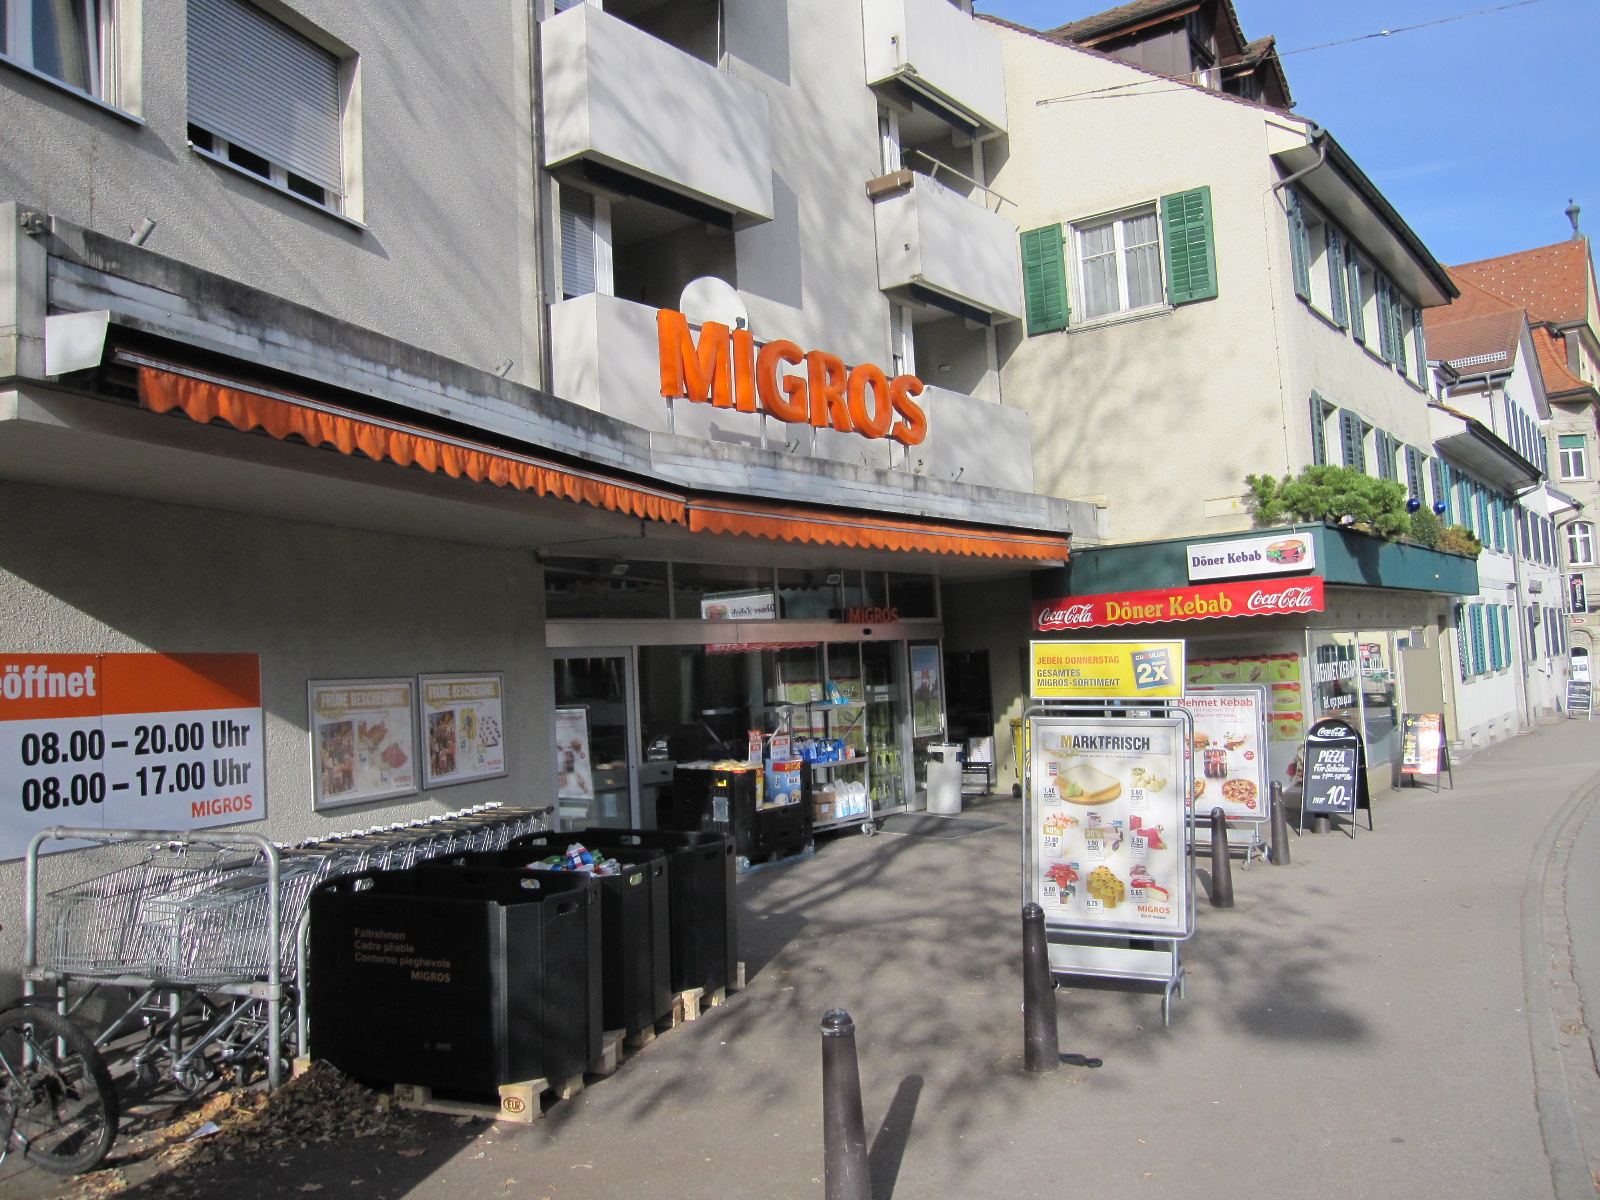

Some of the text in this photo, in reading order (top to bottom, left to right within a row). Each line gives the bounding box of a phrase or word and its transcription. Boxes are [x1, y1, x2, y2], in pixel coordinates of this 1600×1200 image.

[656, 308, 927, 445] MIGROS
[1191, 550, 1262, 568] Döner Kebab
[1247, 586, 1313, 610] Coca-Cola
[1038, 603, 1093, 625] Coca-Cola
[1106, 592, 1232, 621] Döner Kebab
[850, 607, 899, 624] MIGROS
[1037, 655, 1120, 665] JEDEN DONNERSTAG
[1037, 669, 1081, 678] GESAMTES
[1037, 678, 1120, 687] MIGROS-SORTIMENT
[1178, 697, 1253, 707] Mehmet Kebab
[21, 729, 105, 766] 08.00
[134, 722, 204, 755] 20.00
[212, 720, 250, 749] Uhr
[1061, 735, 1150, 751] MARKTFRISCH
[1318, 750, 1345, 763] PIZZA
[22, 772, 106, 811] 08.00
[136, 762, 206, 796] 17.00
[213, 758, 251, 787] Uhr
[191, 795, 253, 818] MIGROS
[1137, 906, 1170, 914] MIGROS
[354, 928, 406, 940] Faltrahmen
[354, 940, 415, 953] Cadre pliable
[355, 952, 451, 968] Contorno pieghevole
[411, 971, 451, 982] MIGROS
[507, 1100, 521, 1110] EUR
